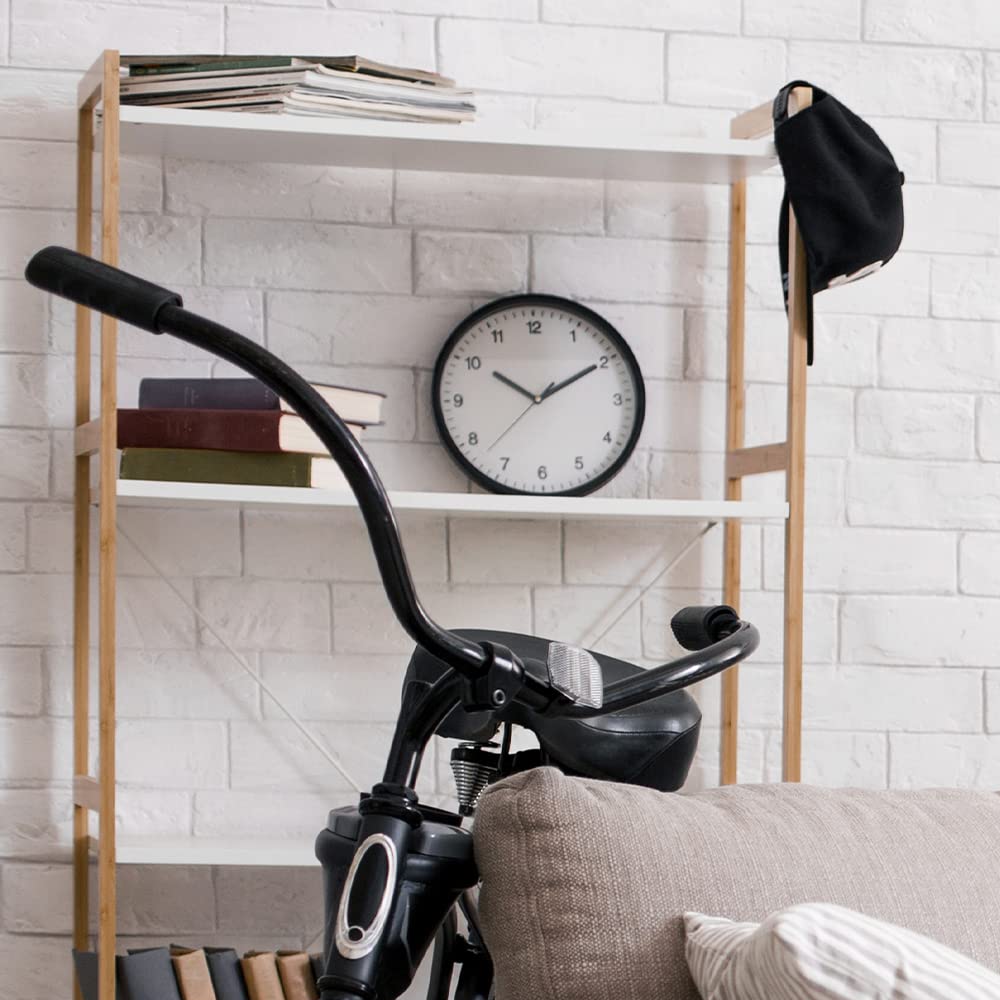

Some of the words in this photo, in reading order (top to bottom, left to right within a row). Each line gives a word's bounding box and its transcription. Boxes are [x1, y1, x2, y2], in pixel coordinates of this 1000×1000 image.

[526, 320, 542, 334] 12
[491, 330, 503, 343] 11
[569, 330, 576, 342] 1
[465, 356, 481, 370] 10
[599, 356, 609, 369] 2
[453, 394, 463, 408] 9
[613, 393, 623, 406] 3
[468, 432, 478, 446] 8
[602, 431, 612, 444] 4
[500, 457, 510, 471] 7
[574, 456, 584, 470] 5
[537, 466, 548, 480] 6
